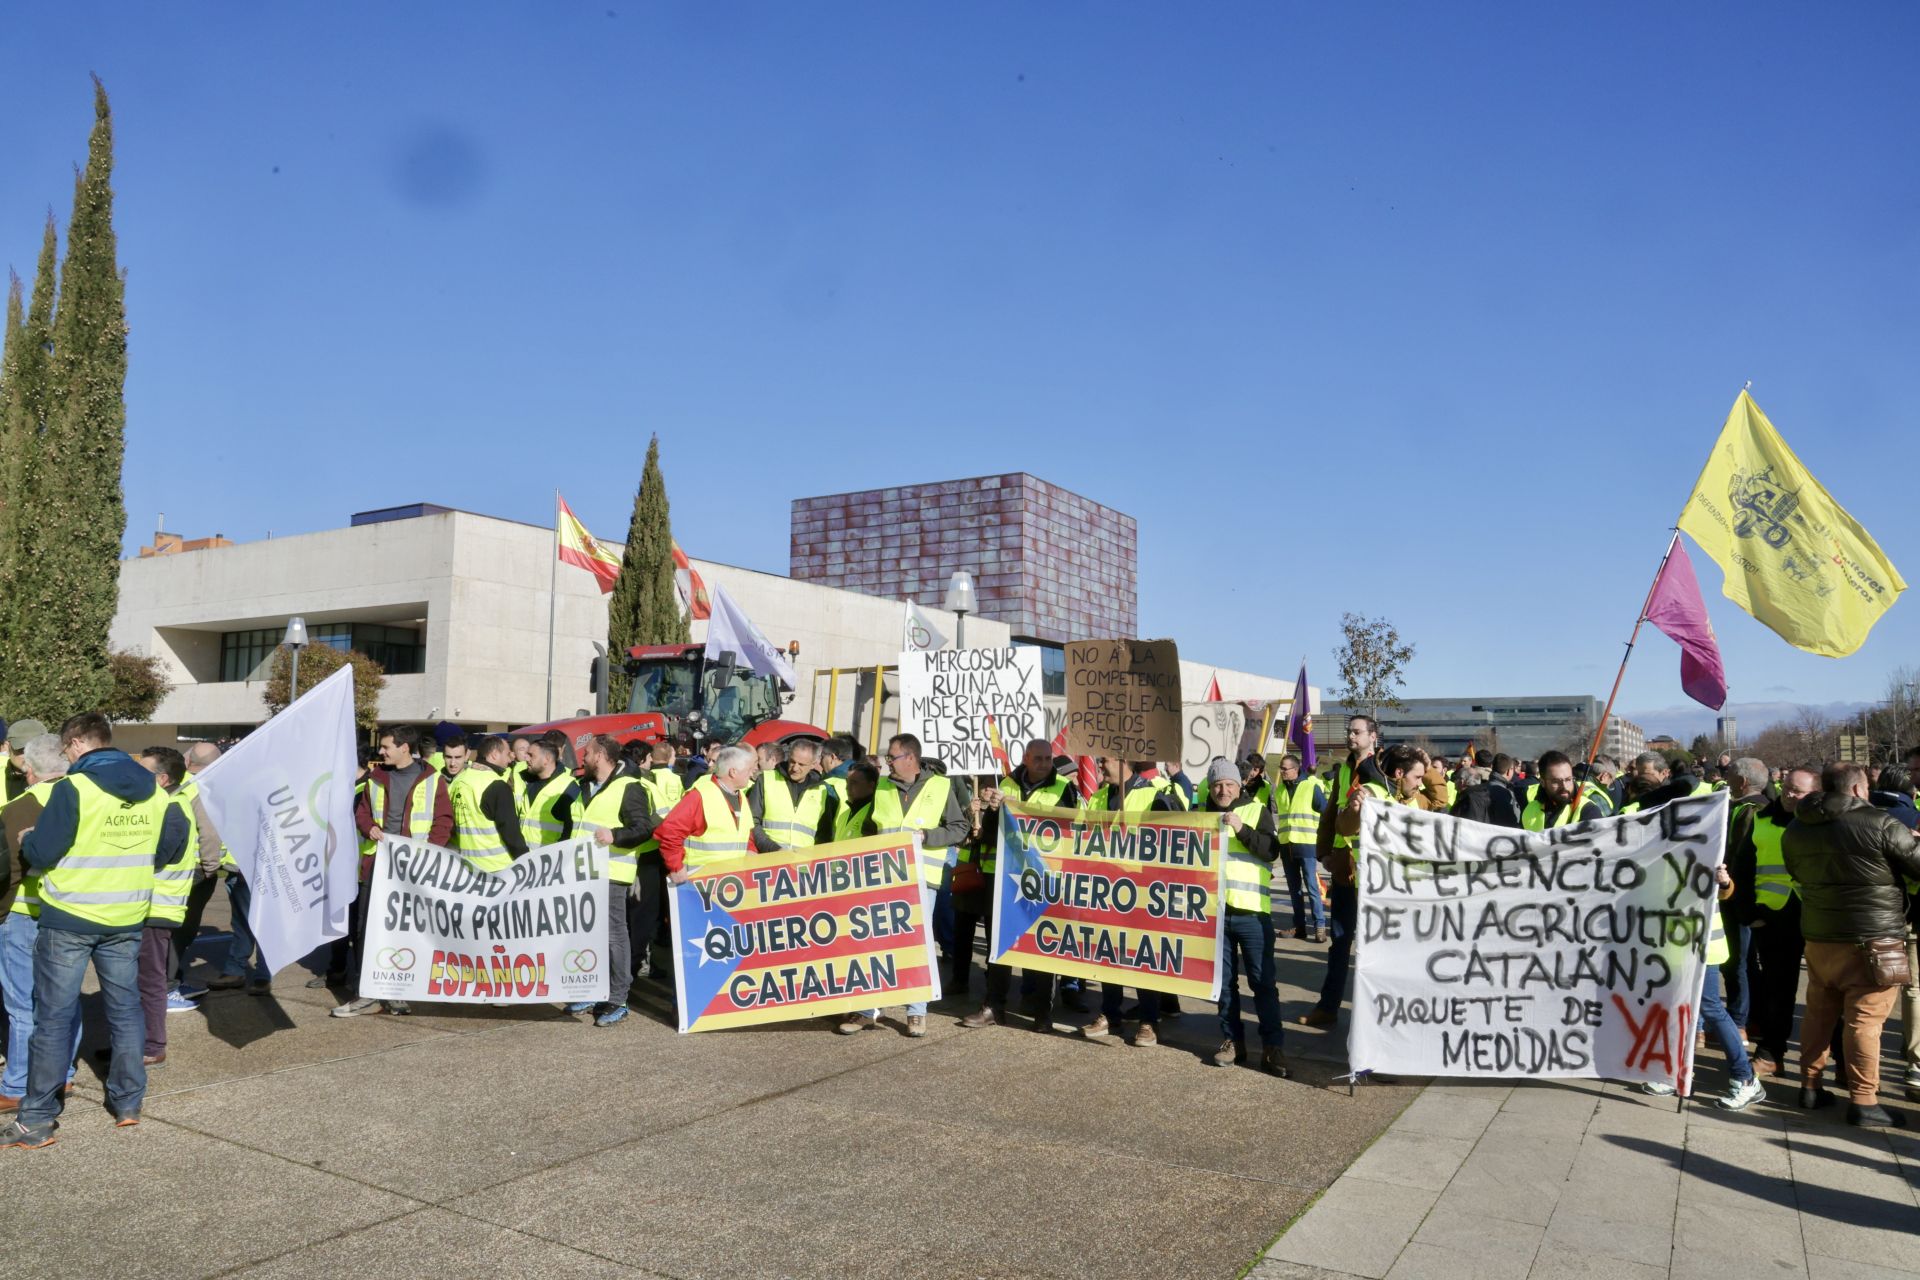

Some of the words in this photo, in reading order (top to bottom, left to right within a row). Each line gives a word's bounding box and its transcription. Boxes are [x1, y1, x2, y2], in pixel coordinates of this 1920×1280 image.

[925, 647, 1020, 673] MERCOSUR
[1072, 647, 1099, 665] NO
[1108, 648, 1120, 665] A
[1131, 648, 1157, 665] LA
[1074, 668, 1181, 689] COMPETENCIA
[932, 669, 1001, 697] RUINA
[1017, 664, 1034, 694] Y
[1086, 690, 1181, 713] DESLEAL
[912, 694, 990, 721] MISERIA
[991, 691, 1042, 714] PARA
[1071, 711, 1146, 734] PRECIOS
[923, 718, 951, 744] EL
[1086, 734, 1158, 757] JUSTOS
[267, 784, 329, 909] UNASPI
[1017, 817, 1062, 854] YO
[1070, 821, 1212, 868] TAMBIEN
[387, 841, 508, 898] IGUALDAD
[509, 849, 565, 895] PARA
[574, 841, 600, 882] EL
[694, 874, 745, 912] YO
[752, 848, 910, 903] TAMBIEN
[384, 890, 465, 940] SECTOR
[472, 890, 597, 941] PRIMARIO
[1020, 867, 1138, 914] QUIERO
[1147, 880, 1209, 924] SER
[703, 911, 838, 962] QUIERO
[847, 900, 916, 943] SER
[1361, 902, 1408, 945] DE
[1412, 900, 1466, 943] UN
[1035, 919, 1184, 976] CATALAN
[372, 970, 416, 983] UNASPI
[427, 944, 550, 997] ESPAÑOL
[561, 973, 599, 985] UNASPI
[728, 953, 899, 1009] CATALAN
[1425, 943, 1672, 1006] CATALÁN?
[1373, 993, 1535, 1027] PAQUETE
[1560, 995, 1605, 1027] DE
[1441, 1026, 1591, 1075] MEDIDAS
